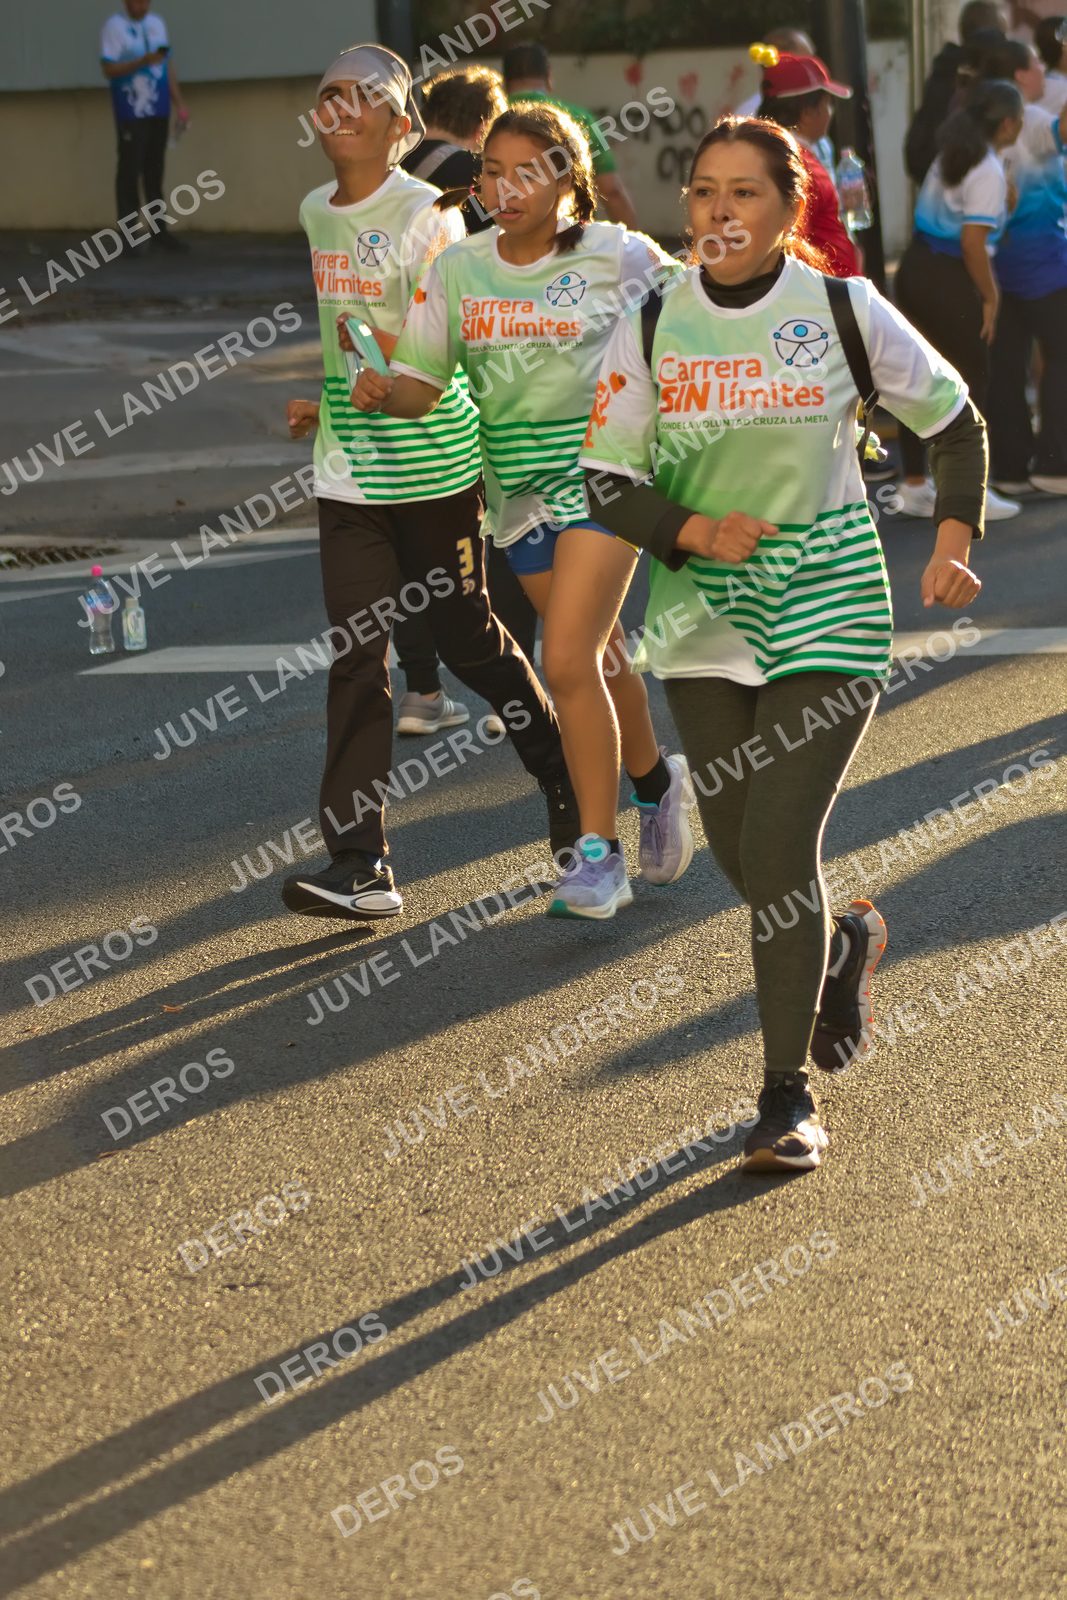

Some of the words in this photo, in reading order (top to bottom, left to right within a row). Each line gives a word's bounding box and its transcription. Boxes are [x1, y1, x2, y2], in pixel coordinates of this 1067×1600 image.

[461, 298, 534, 318] Carrera
[461, 316, 496, 341] SIN
[501, 316, 580, 337] límites
[658, 357, 762, 385] Carrera
[659, 381, 711, 413] SIN
[719, 381, 825, 411] límites
[753, 416, 787, 426] CRUZA
[790, 416, 802, 425] LA
[805, 415, 829, 424] META
